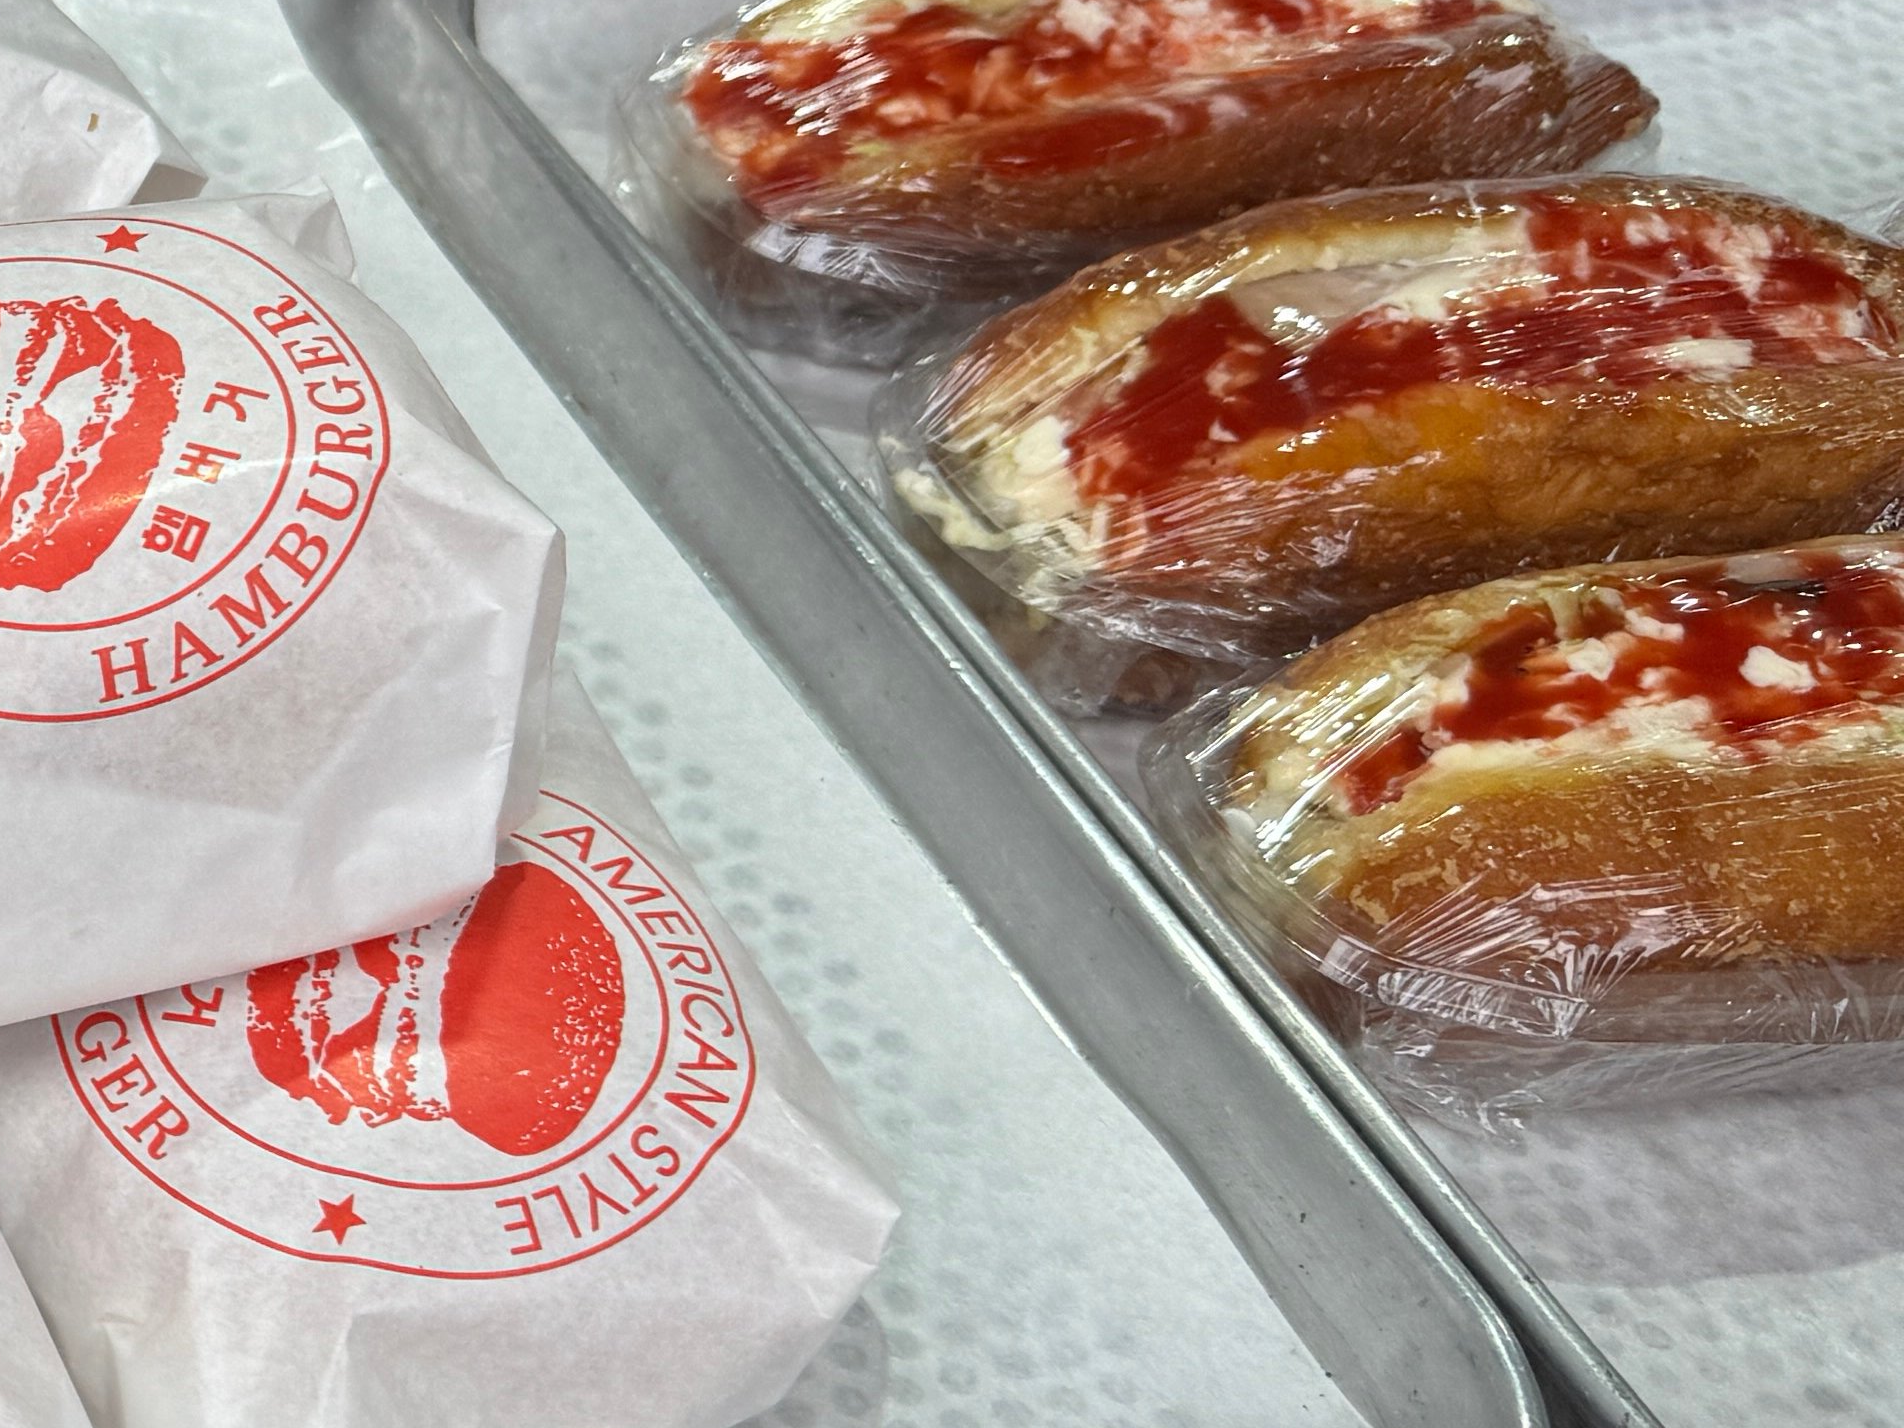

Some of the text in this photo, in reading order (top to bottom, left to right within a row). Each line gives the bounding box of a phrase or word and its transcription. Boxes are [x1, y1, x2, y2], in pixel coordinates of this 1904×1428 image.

[91, 292, 374, 705] HAMBURGER
[140, 380, 271, 563] 햄버거
[494, 824, 739, 1256] AMERICAN STYLE
